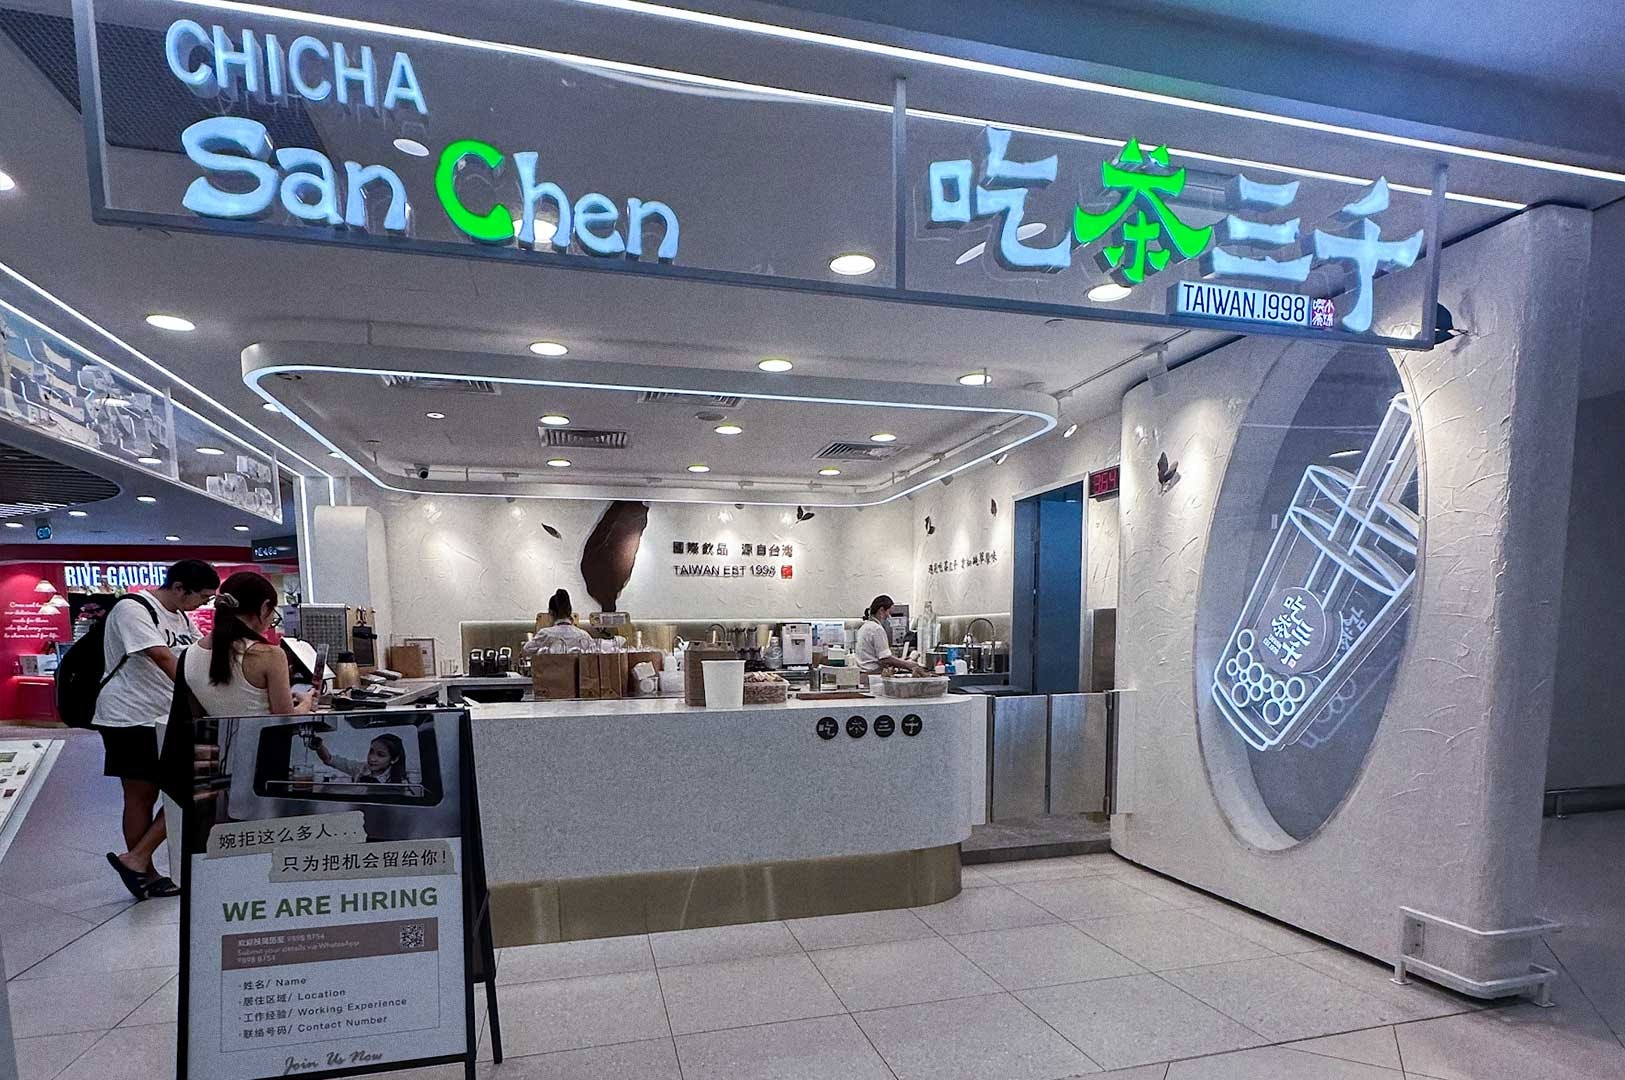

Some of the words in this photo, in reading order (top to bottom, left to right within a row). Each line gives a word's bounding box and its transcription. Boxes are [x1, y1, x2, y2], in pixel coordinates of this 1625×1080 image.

[166, 19, 429, 115] CHICHA
[181, 116, 409, 231] San
[436, 138, 680, 260] Chen
[929, 125, 1424, 332] 吃茶三千
[1184, 284, 1306, 322] TAIWAN.1998
[673, 565, 720, 577] TAIWAN
[723, 565, 746, 577] EST
[750, 564, 777, 578] 1998
[222, 900, 267, 922] WE
[275, 895, 331, 918] ARE
[341, 887, 438, 912] HIRING
[276, 978, 307, 986] Name
[298, 989, 346, 1001] Location
[298, 1005, 343, 1016] Working
[347, 998, 407, 1011] Experience
[298, 1020, 342, 1033] Contact
[346, 1016, 388, 1026] Number
[284, 1056, 319, 1076] Join
[350, 1050, 384, 1063] Now
